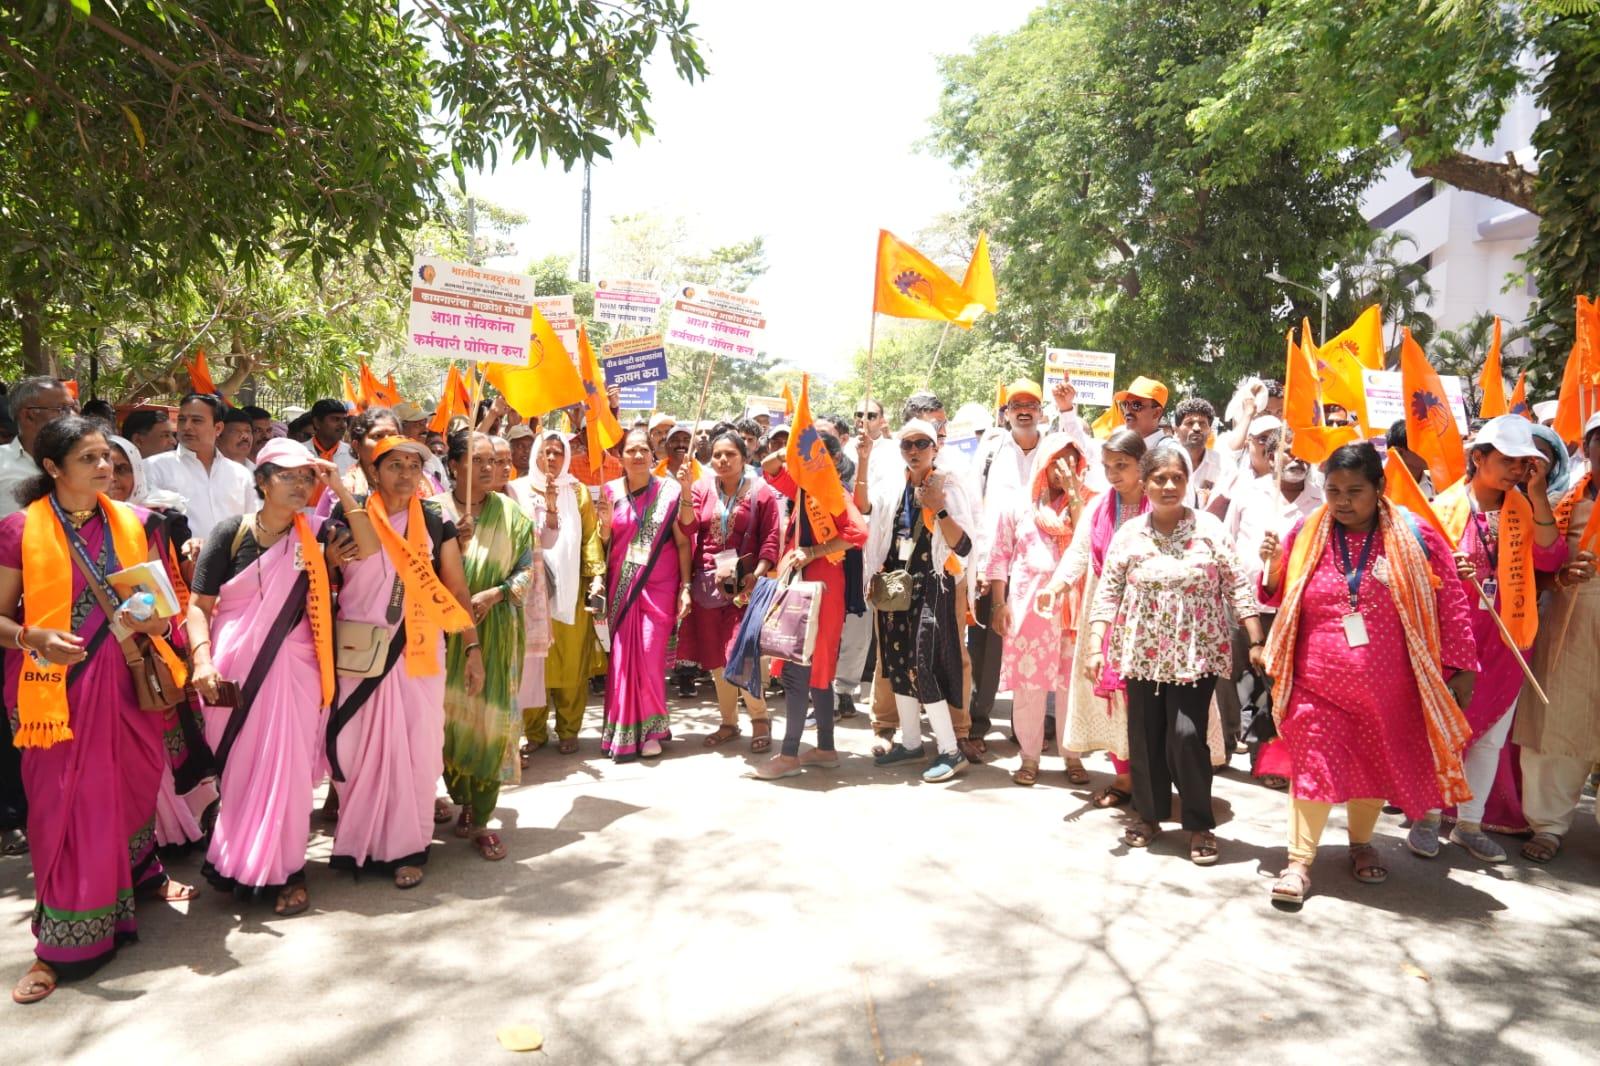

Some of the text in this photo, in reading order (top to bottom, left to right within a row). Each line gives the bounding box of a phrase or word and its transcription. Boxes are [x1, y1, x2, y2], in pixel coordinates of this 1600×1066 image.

[432, 310, 515, 334] आशा सेविकांना
[687, 316, 750, 338] आशा सेविकांना
[414, 331, 460, 350] कर्मचारी
[464, 337, 498, 355] घोषित
[614, 368, 659, 383] कायम करा
[24, 672, 61, 682] BMS
